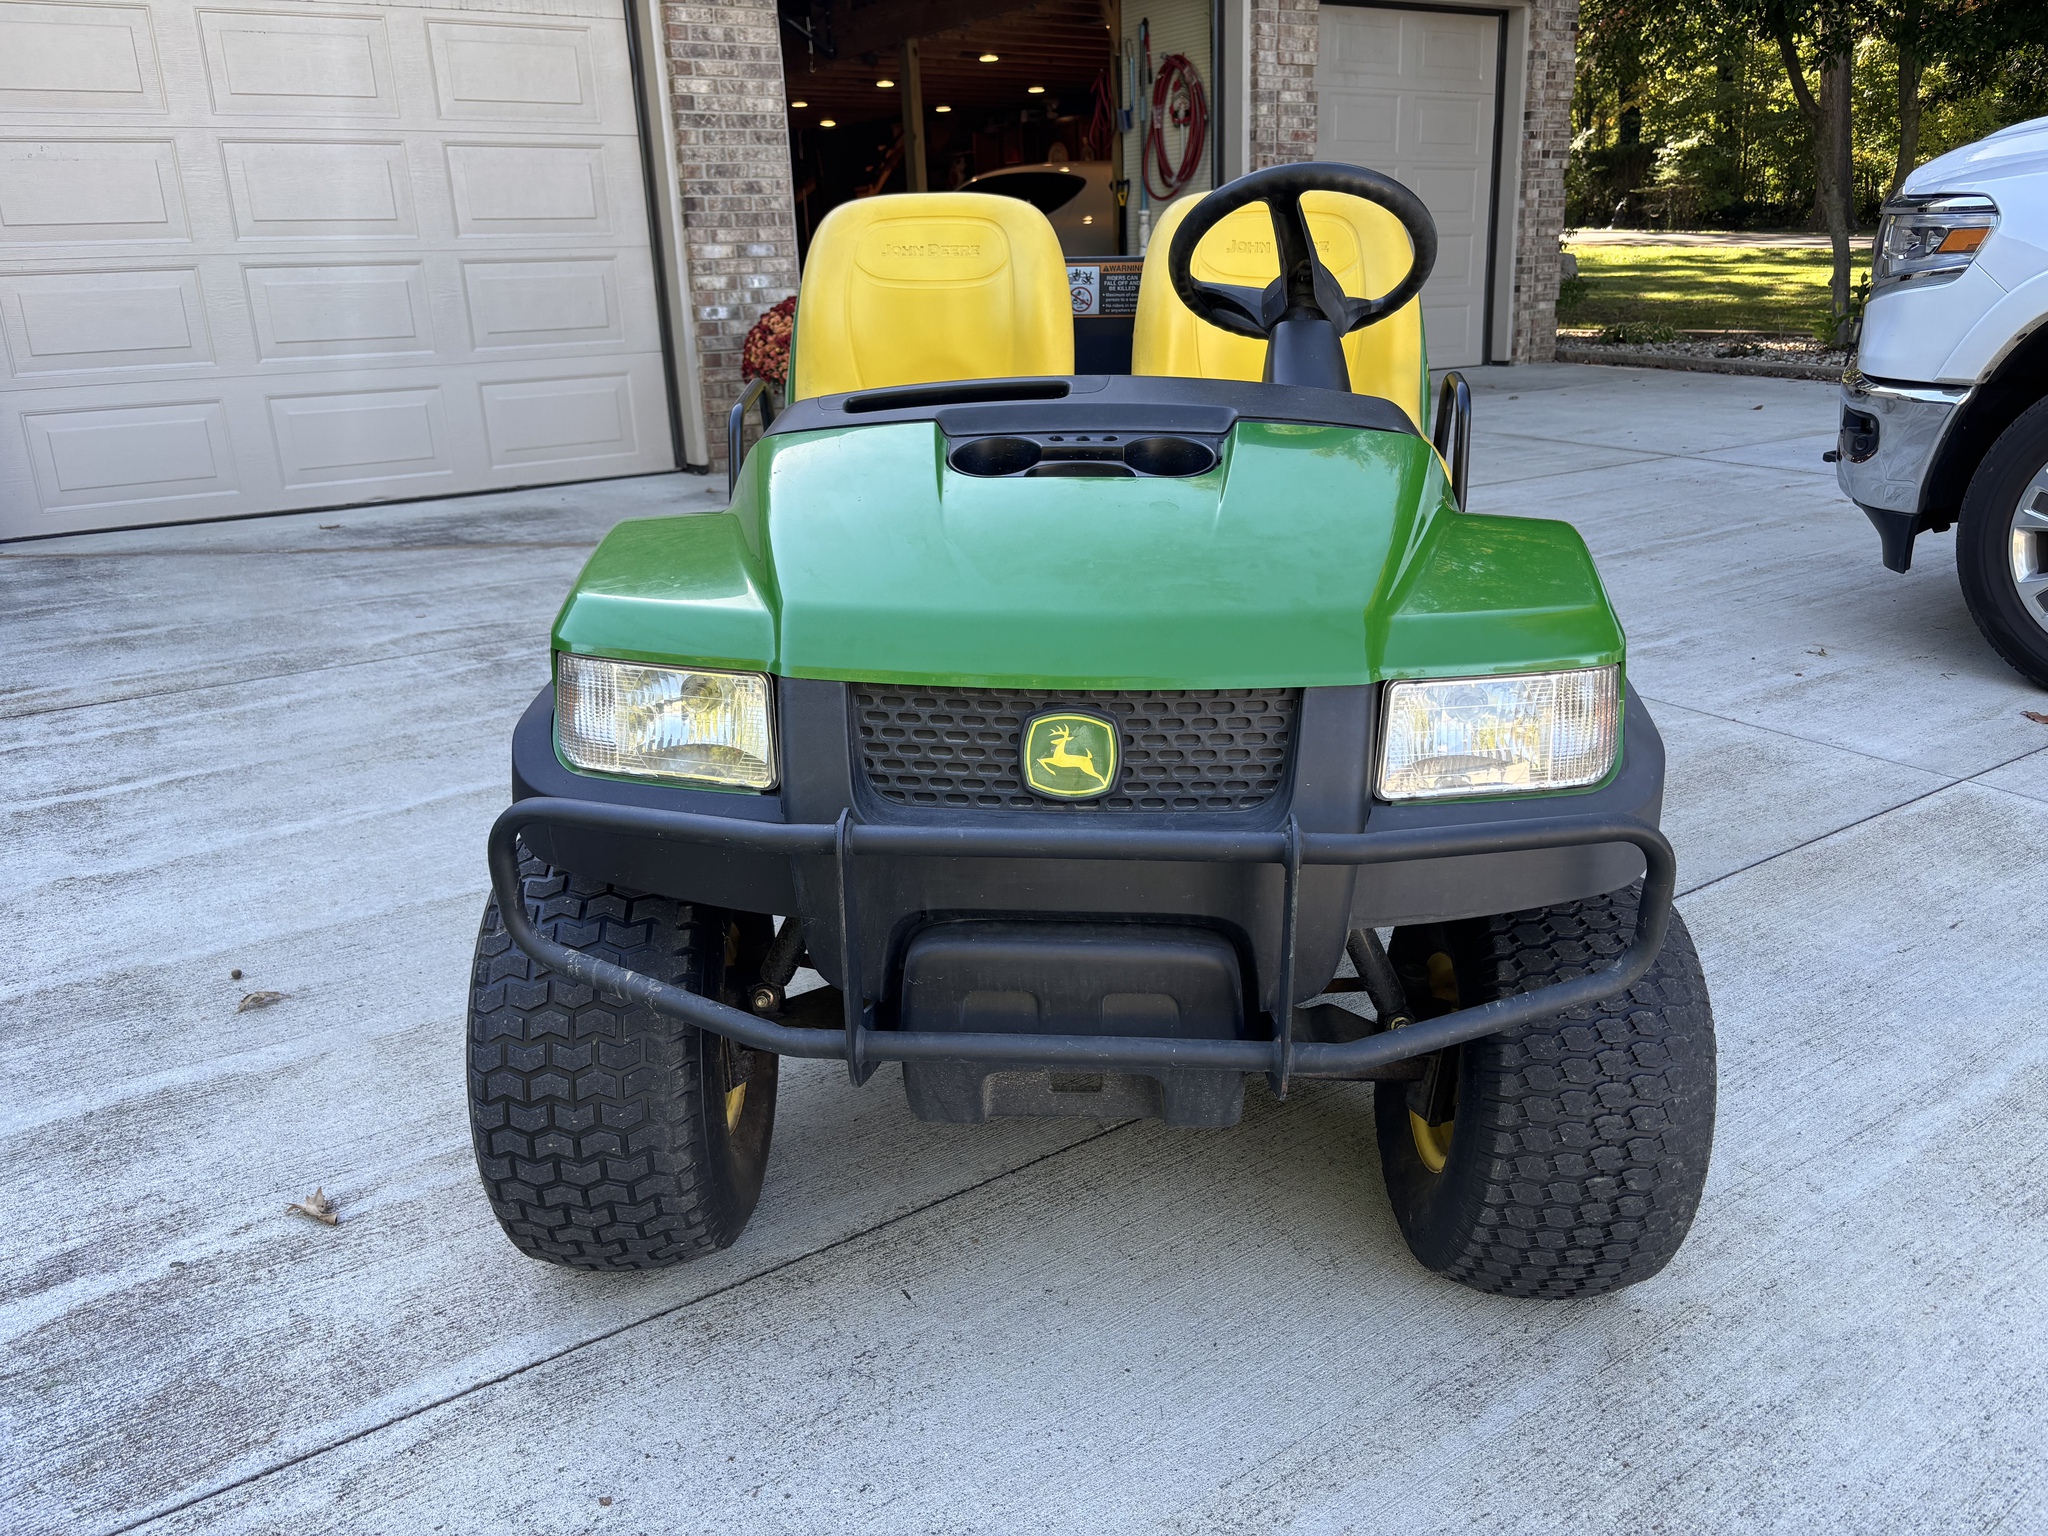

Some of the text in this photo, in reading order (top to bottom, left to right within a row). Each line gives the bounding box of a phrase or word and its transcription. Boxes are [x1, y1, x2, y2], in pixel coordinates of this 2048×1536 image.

[881, 243, 980, 257] JOHN DEERE
[1226, 239, 1271, 254] JOHN
